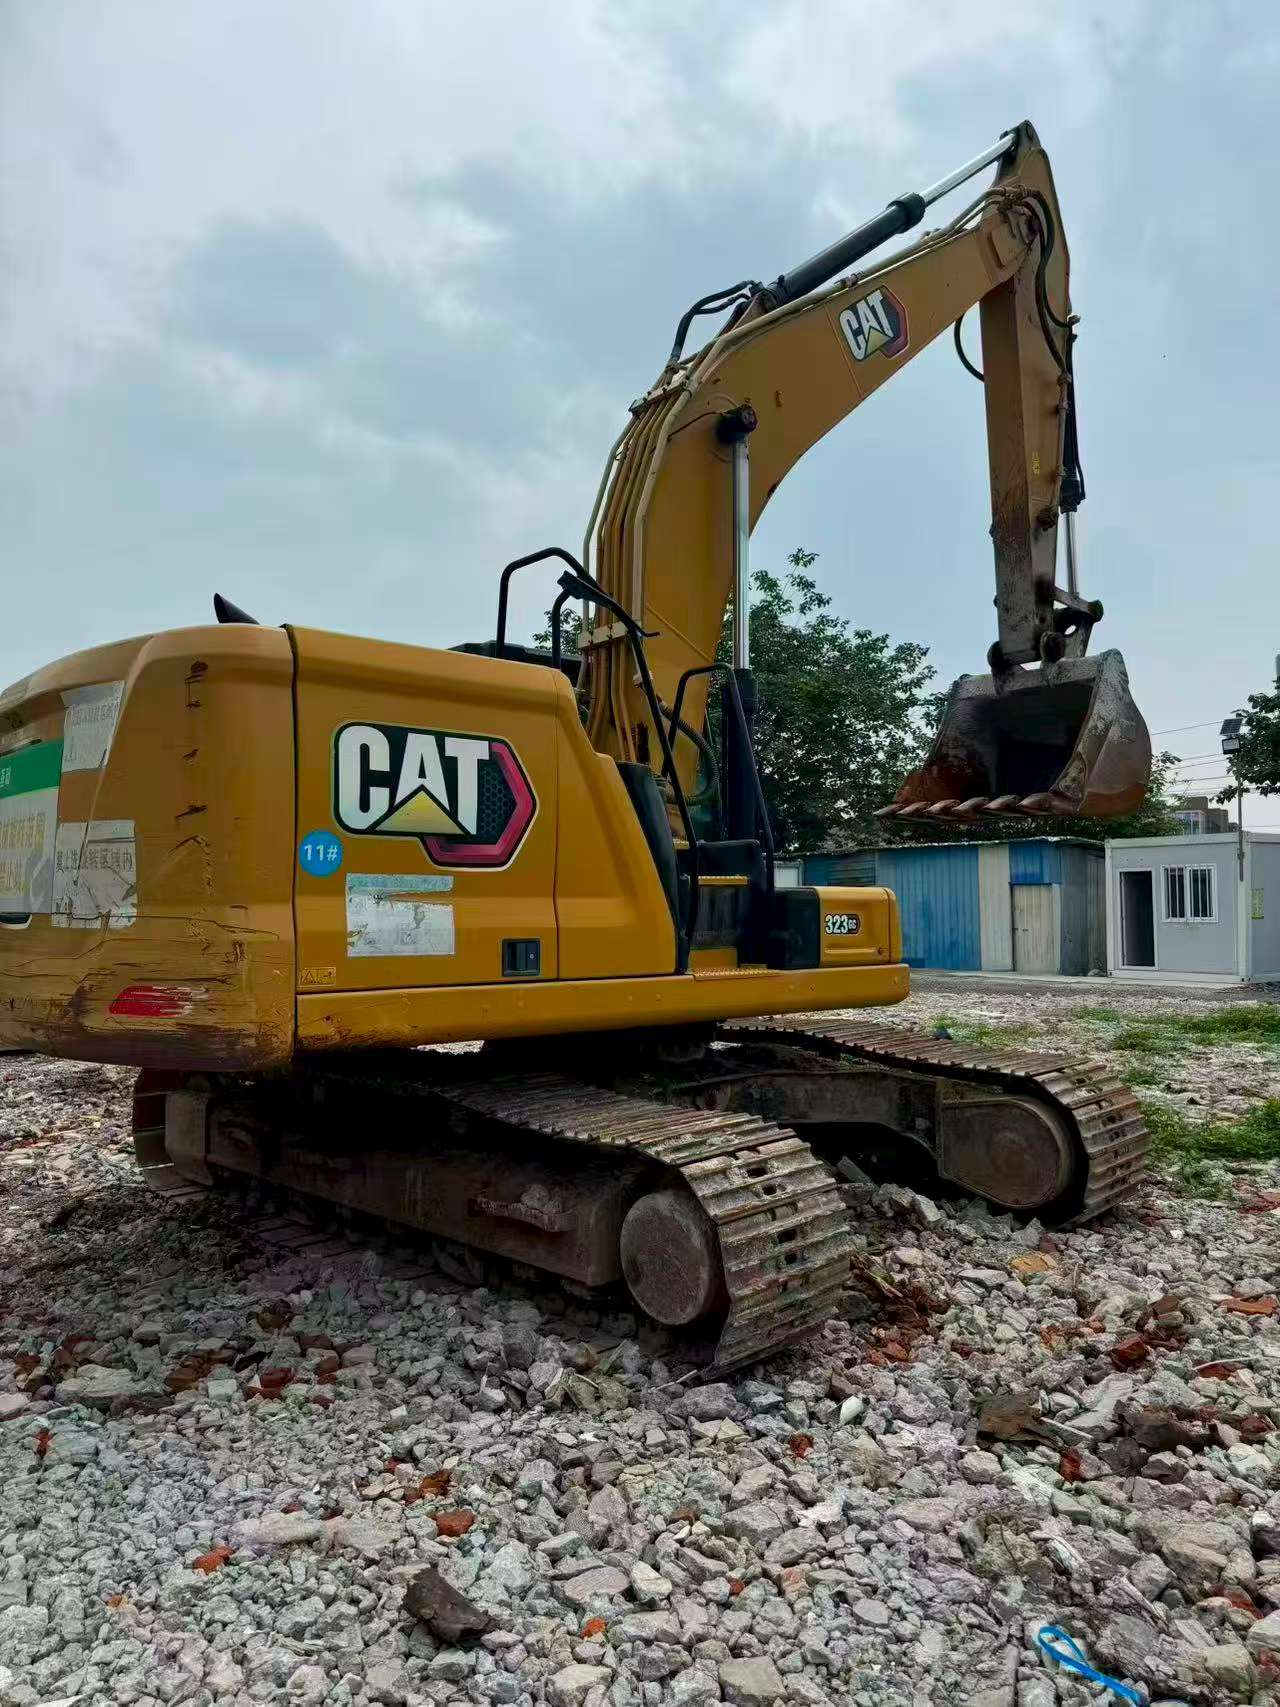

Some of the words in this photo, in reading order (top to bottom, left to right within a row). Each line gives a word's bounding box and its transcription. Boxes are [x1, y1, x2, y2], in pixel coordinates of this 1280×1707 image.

[840, 289, 894, 360] CAT
[338, 725, 489, 834] CAT
[304, 844, 338, 861] 11#
